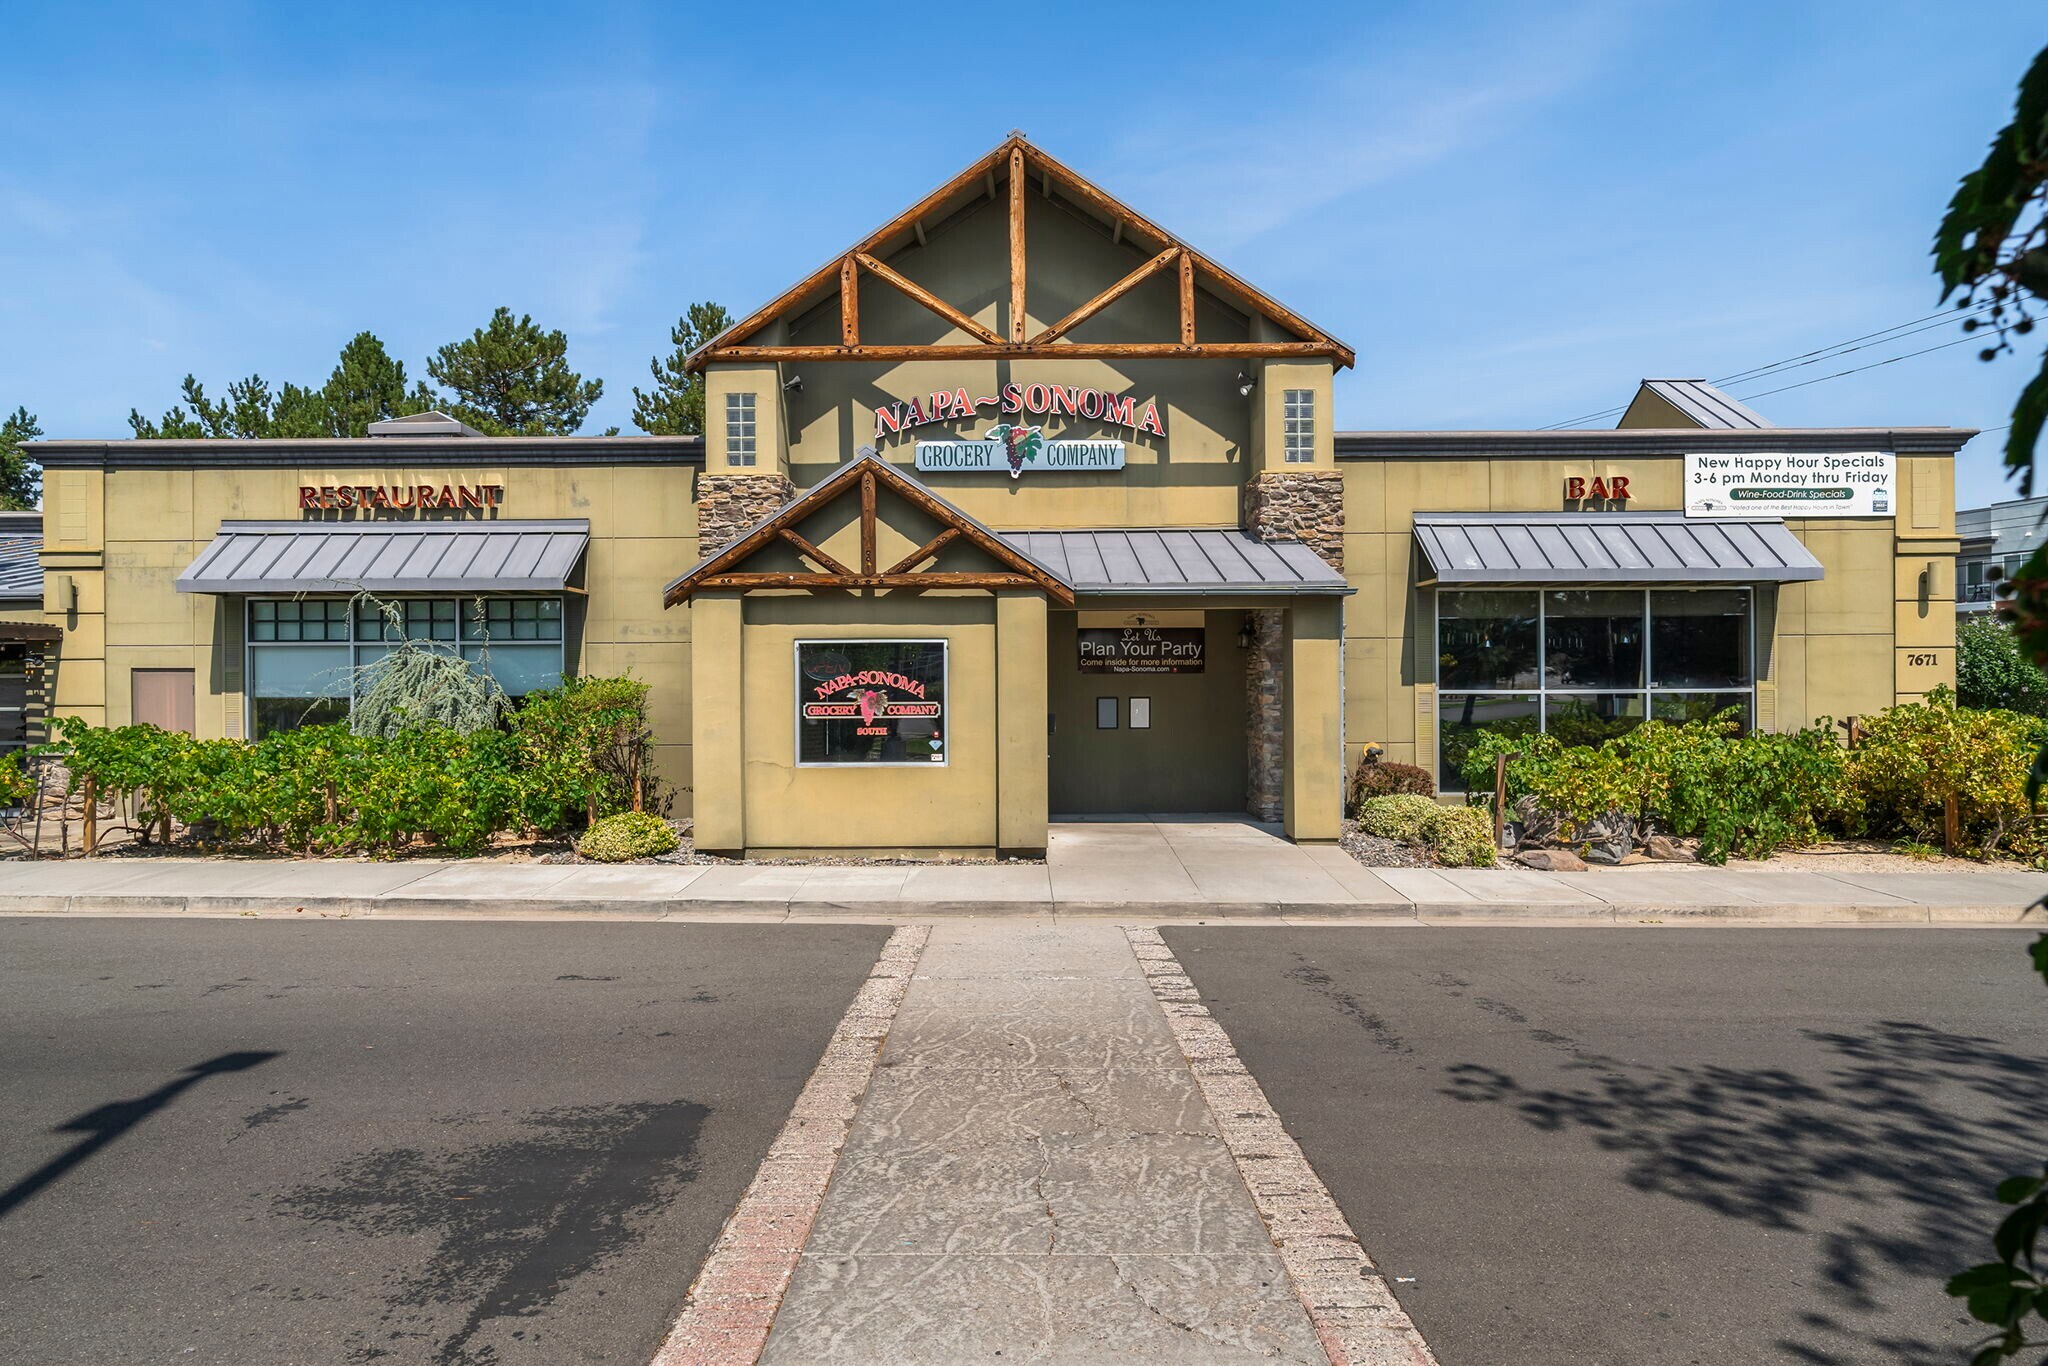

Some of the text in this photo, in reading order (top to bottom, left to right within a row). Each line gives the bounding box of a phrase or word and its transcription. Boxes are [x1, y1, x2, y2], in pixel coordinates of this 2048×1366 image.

[922, 443, 1118, 467] GROCERY COMPANY
[1698, 456, 1885, 470] New Happy Hour Specials
[1694, 471, 1888, 486] 3-6 pm Monday thru Friday
[1566, 476, 1631, 499] BAR
[299, 485, 504, 508] RESTAURANT
[1738, 490, 1846, 499] Wine-Food-Drink Specials
[1121, 628, 1162, 641] Let Us
[1080, 641, 1202, 659] Plan Your Party
[1104, 658, 1127, 666] inside
[1128, 658, 1139, 666] for
[1161, 658, 1203, 666] information
[1907, 654, 1938, 666] 7671
[807, 705, 937, 716] GROCERY COMPANY
[856, 727, 888, 736] SOUTH
